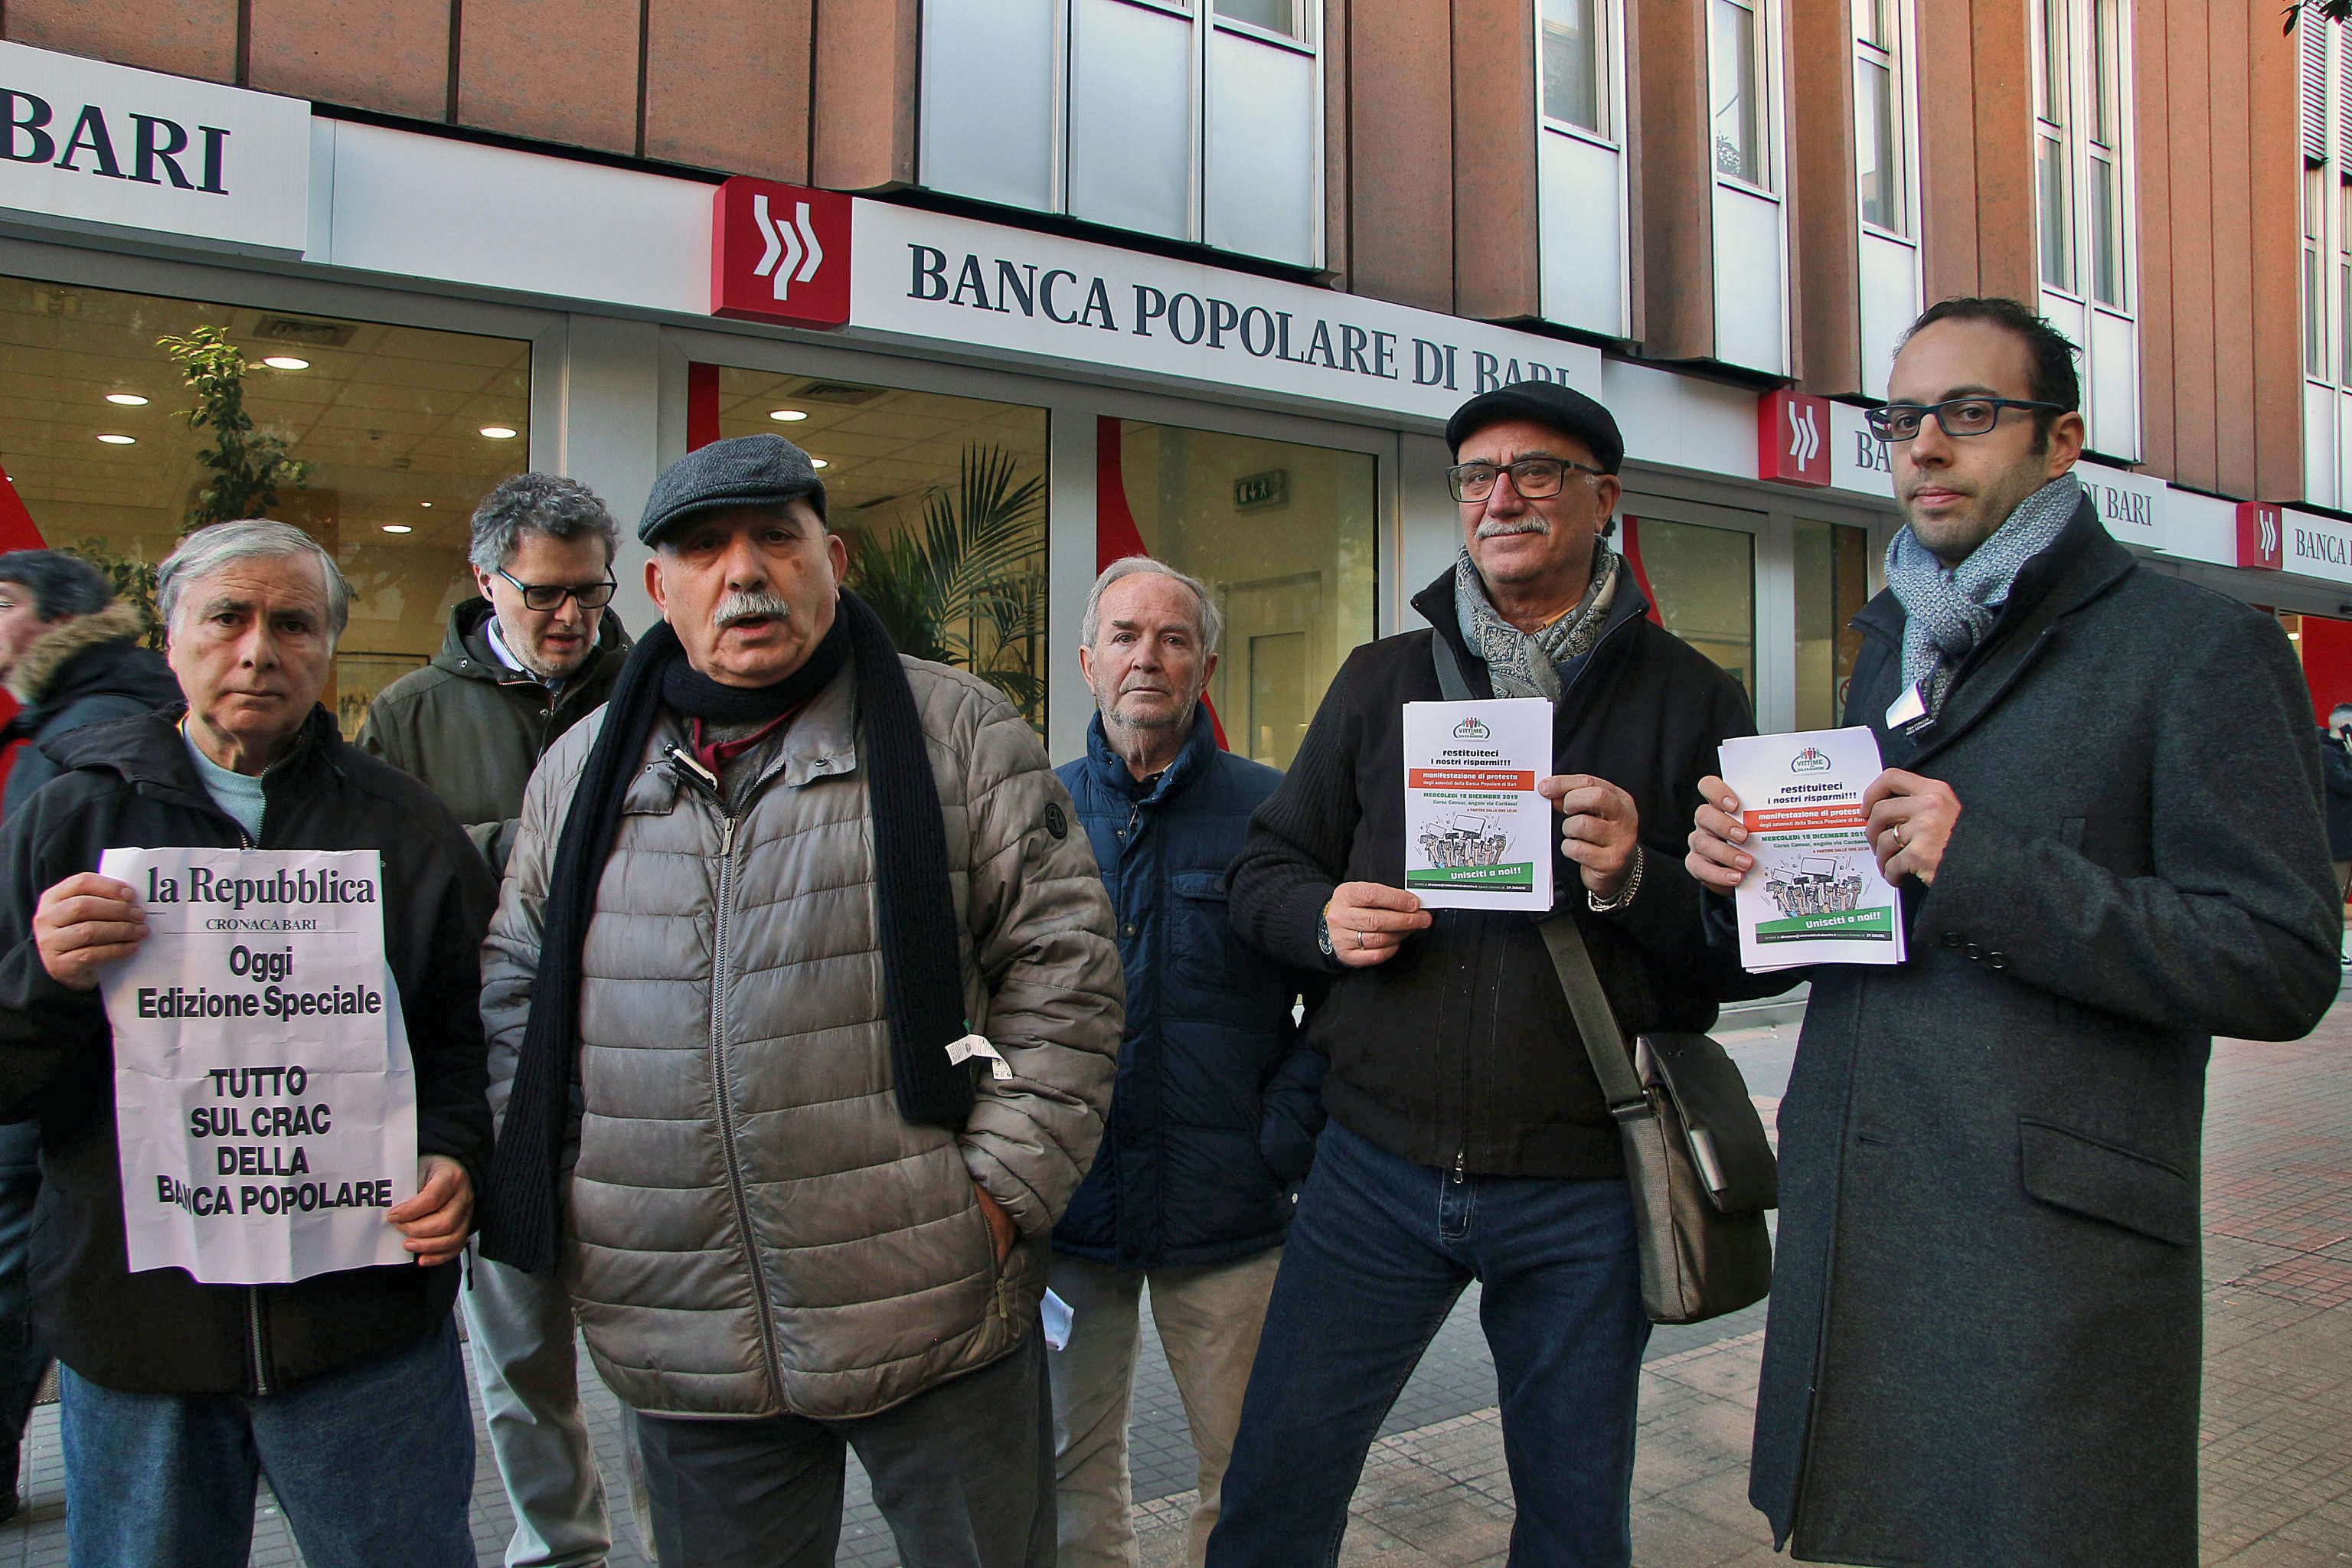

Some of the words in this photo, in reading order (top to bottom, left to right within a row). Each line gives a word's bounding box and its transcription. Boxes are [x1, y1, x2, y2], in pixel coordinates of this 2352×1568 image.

[0, 88, 230, 195] BARI
[906, 243, 1117, 331] BANCA
[1132, 283, 1398, 381] POPOLARE
[1411, 337, 1459, 390] DI
[2105, 486, 2152, 527] BARI
[2295, 528, 2346, 564] BANCA
[1781, 782, 1842, 794] restituiteci
[1805, 792, 1857, 803] risparmi!!!
[1759, 811, 1818, 820] manifestazione
[1831, 808, 1860, 818] protest
[148, 866, 180, 903] la
[188, 866, 375, 910] Repubblica
[1451, 870, 1487, 880] Unisciti
[1498, 867, 1521, 876] noi!!
[205, 918, 279, 930] CRONACA
[283, 918, 317, 931] BARI
[1805, 916, 1845, 928] Unisciti
[1857, 912, 1880, 922] noi!!
[230, 945, 293, 981] Oggi
[138, 986, 259, 1018] Edizione
[263, 985, 382, 1021] Speciale
[209, 1066, 308, 1097] TUTTO
[191, 1106, 249, 1137] SUL
[252, 1103, 331, 1137] CRAC
[217, 1146, 309, 1176] DELLA
[158, 1174, 234, 1216] BANCA
[241, 1179, 392, 1215] POPOLARE
